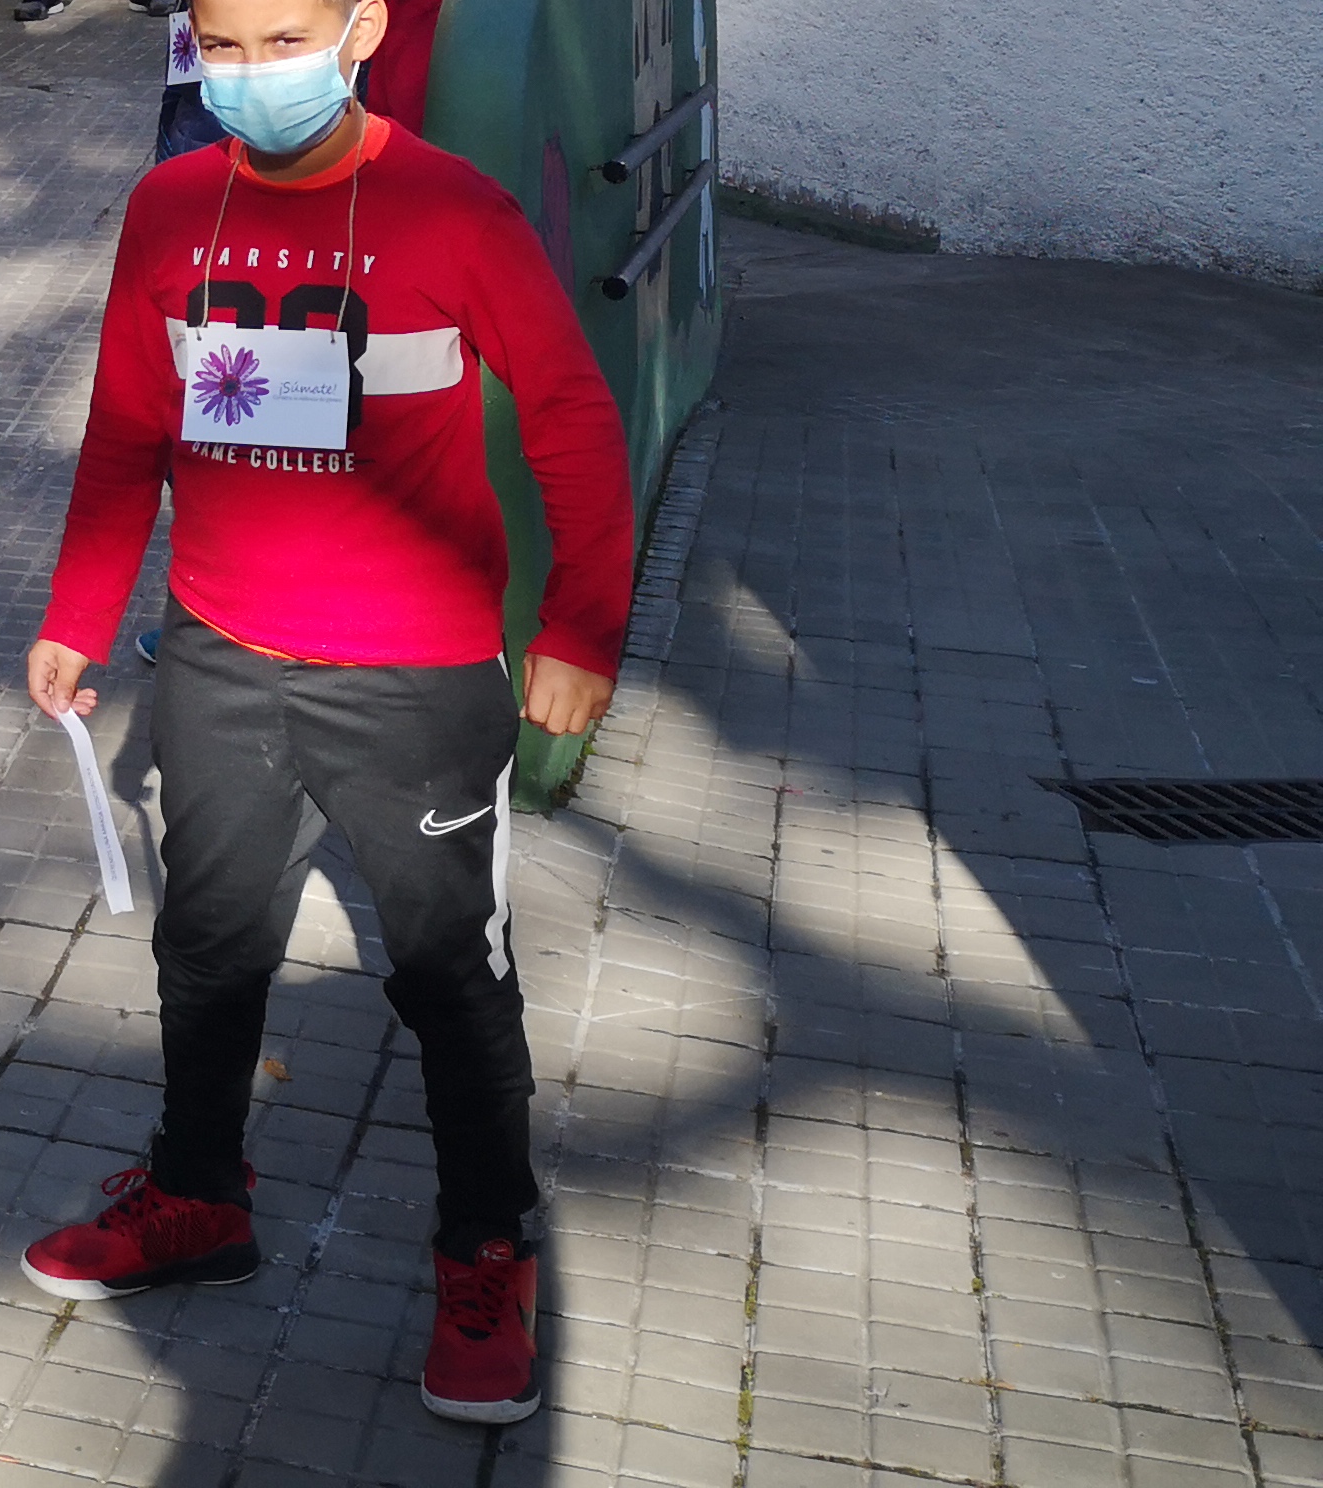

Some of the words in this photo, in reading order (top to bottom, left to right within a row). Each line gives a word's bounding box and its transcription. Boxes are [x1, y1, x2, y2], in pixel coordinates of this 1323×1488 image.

[192, 246, 376, 275] VARSITY
[278, 380, 338, 395] ¡Súmate!
[250, 447, 356, 473] COLLEGE
